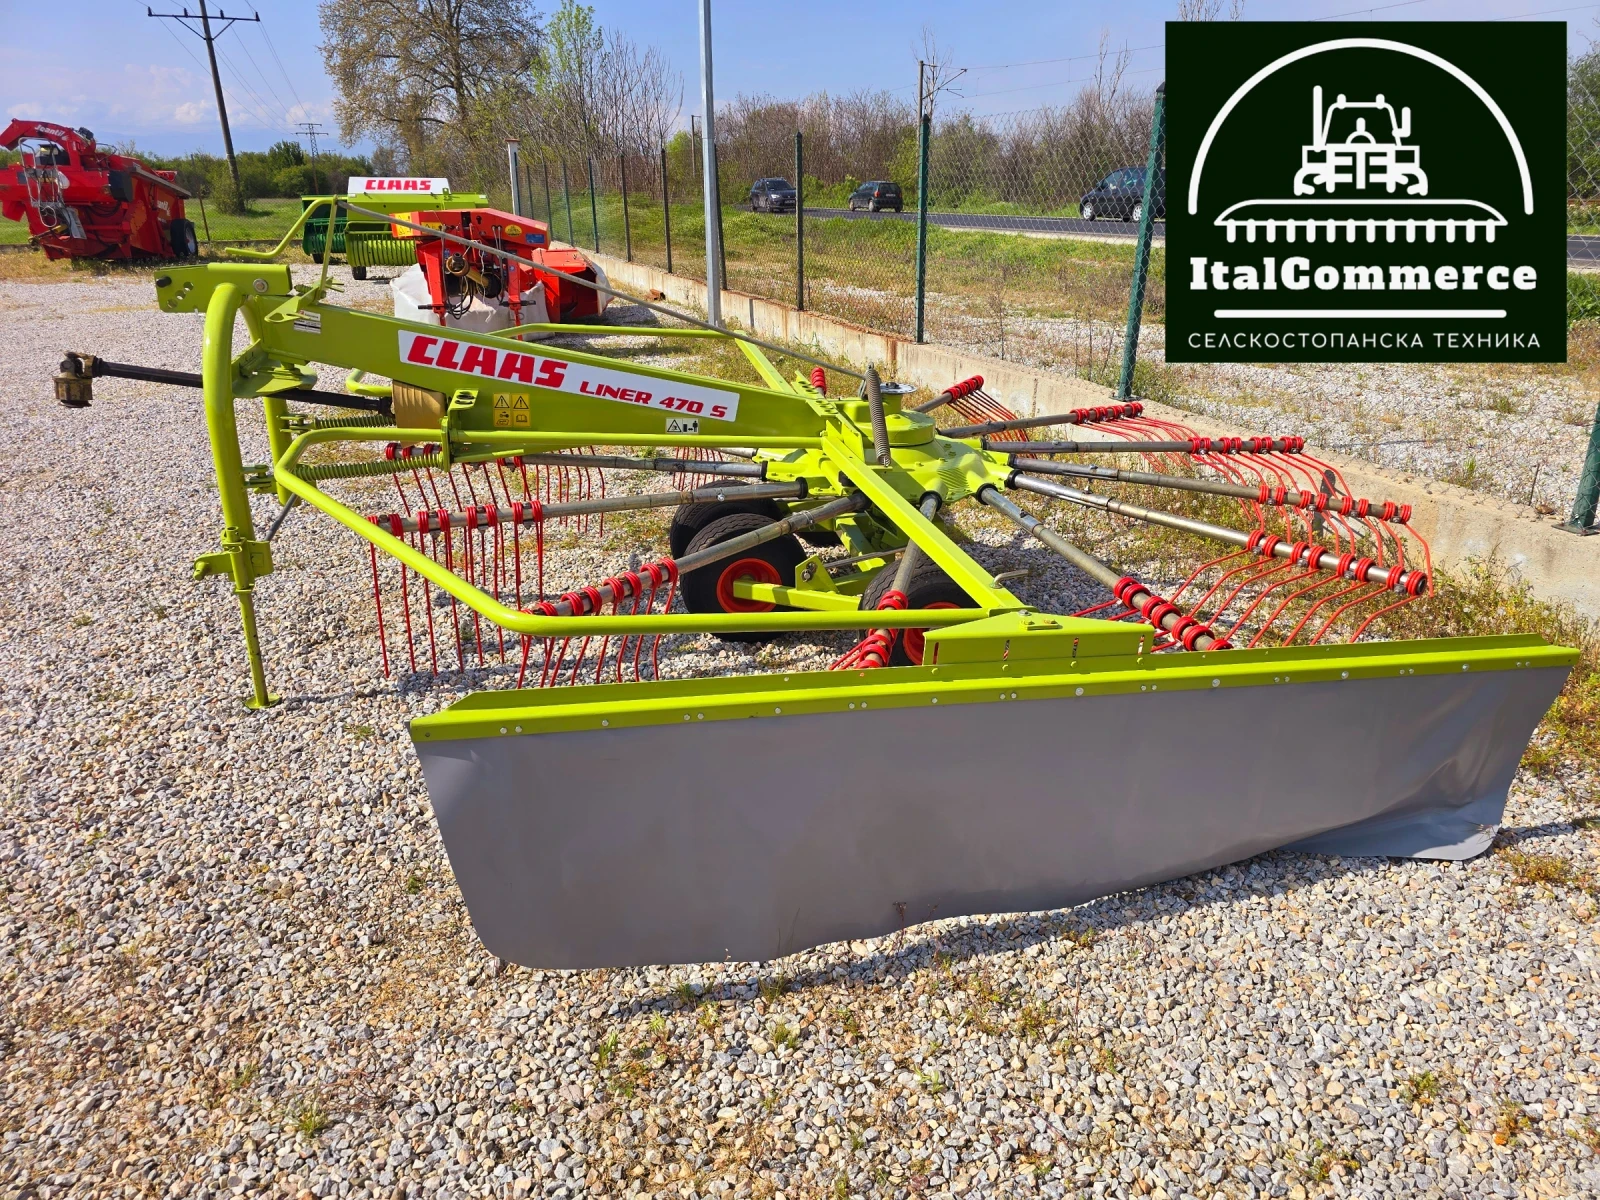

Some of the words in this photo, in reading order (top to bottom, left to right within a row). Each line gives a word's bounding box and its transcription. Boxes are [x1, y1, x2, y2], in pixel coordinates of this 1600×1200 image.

[365, 179, 431, 191] CLAAS
[407, 335, 568, 389] CLAAS
[579, 381, 653, 405] LINER
[659, 396, 704, 414] 470
[710, 405, 728, 419] S
